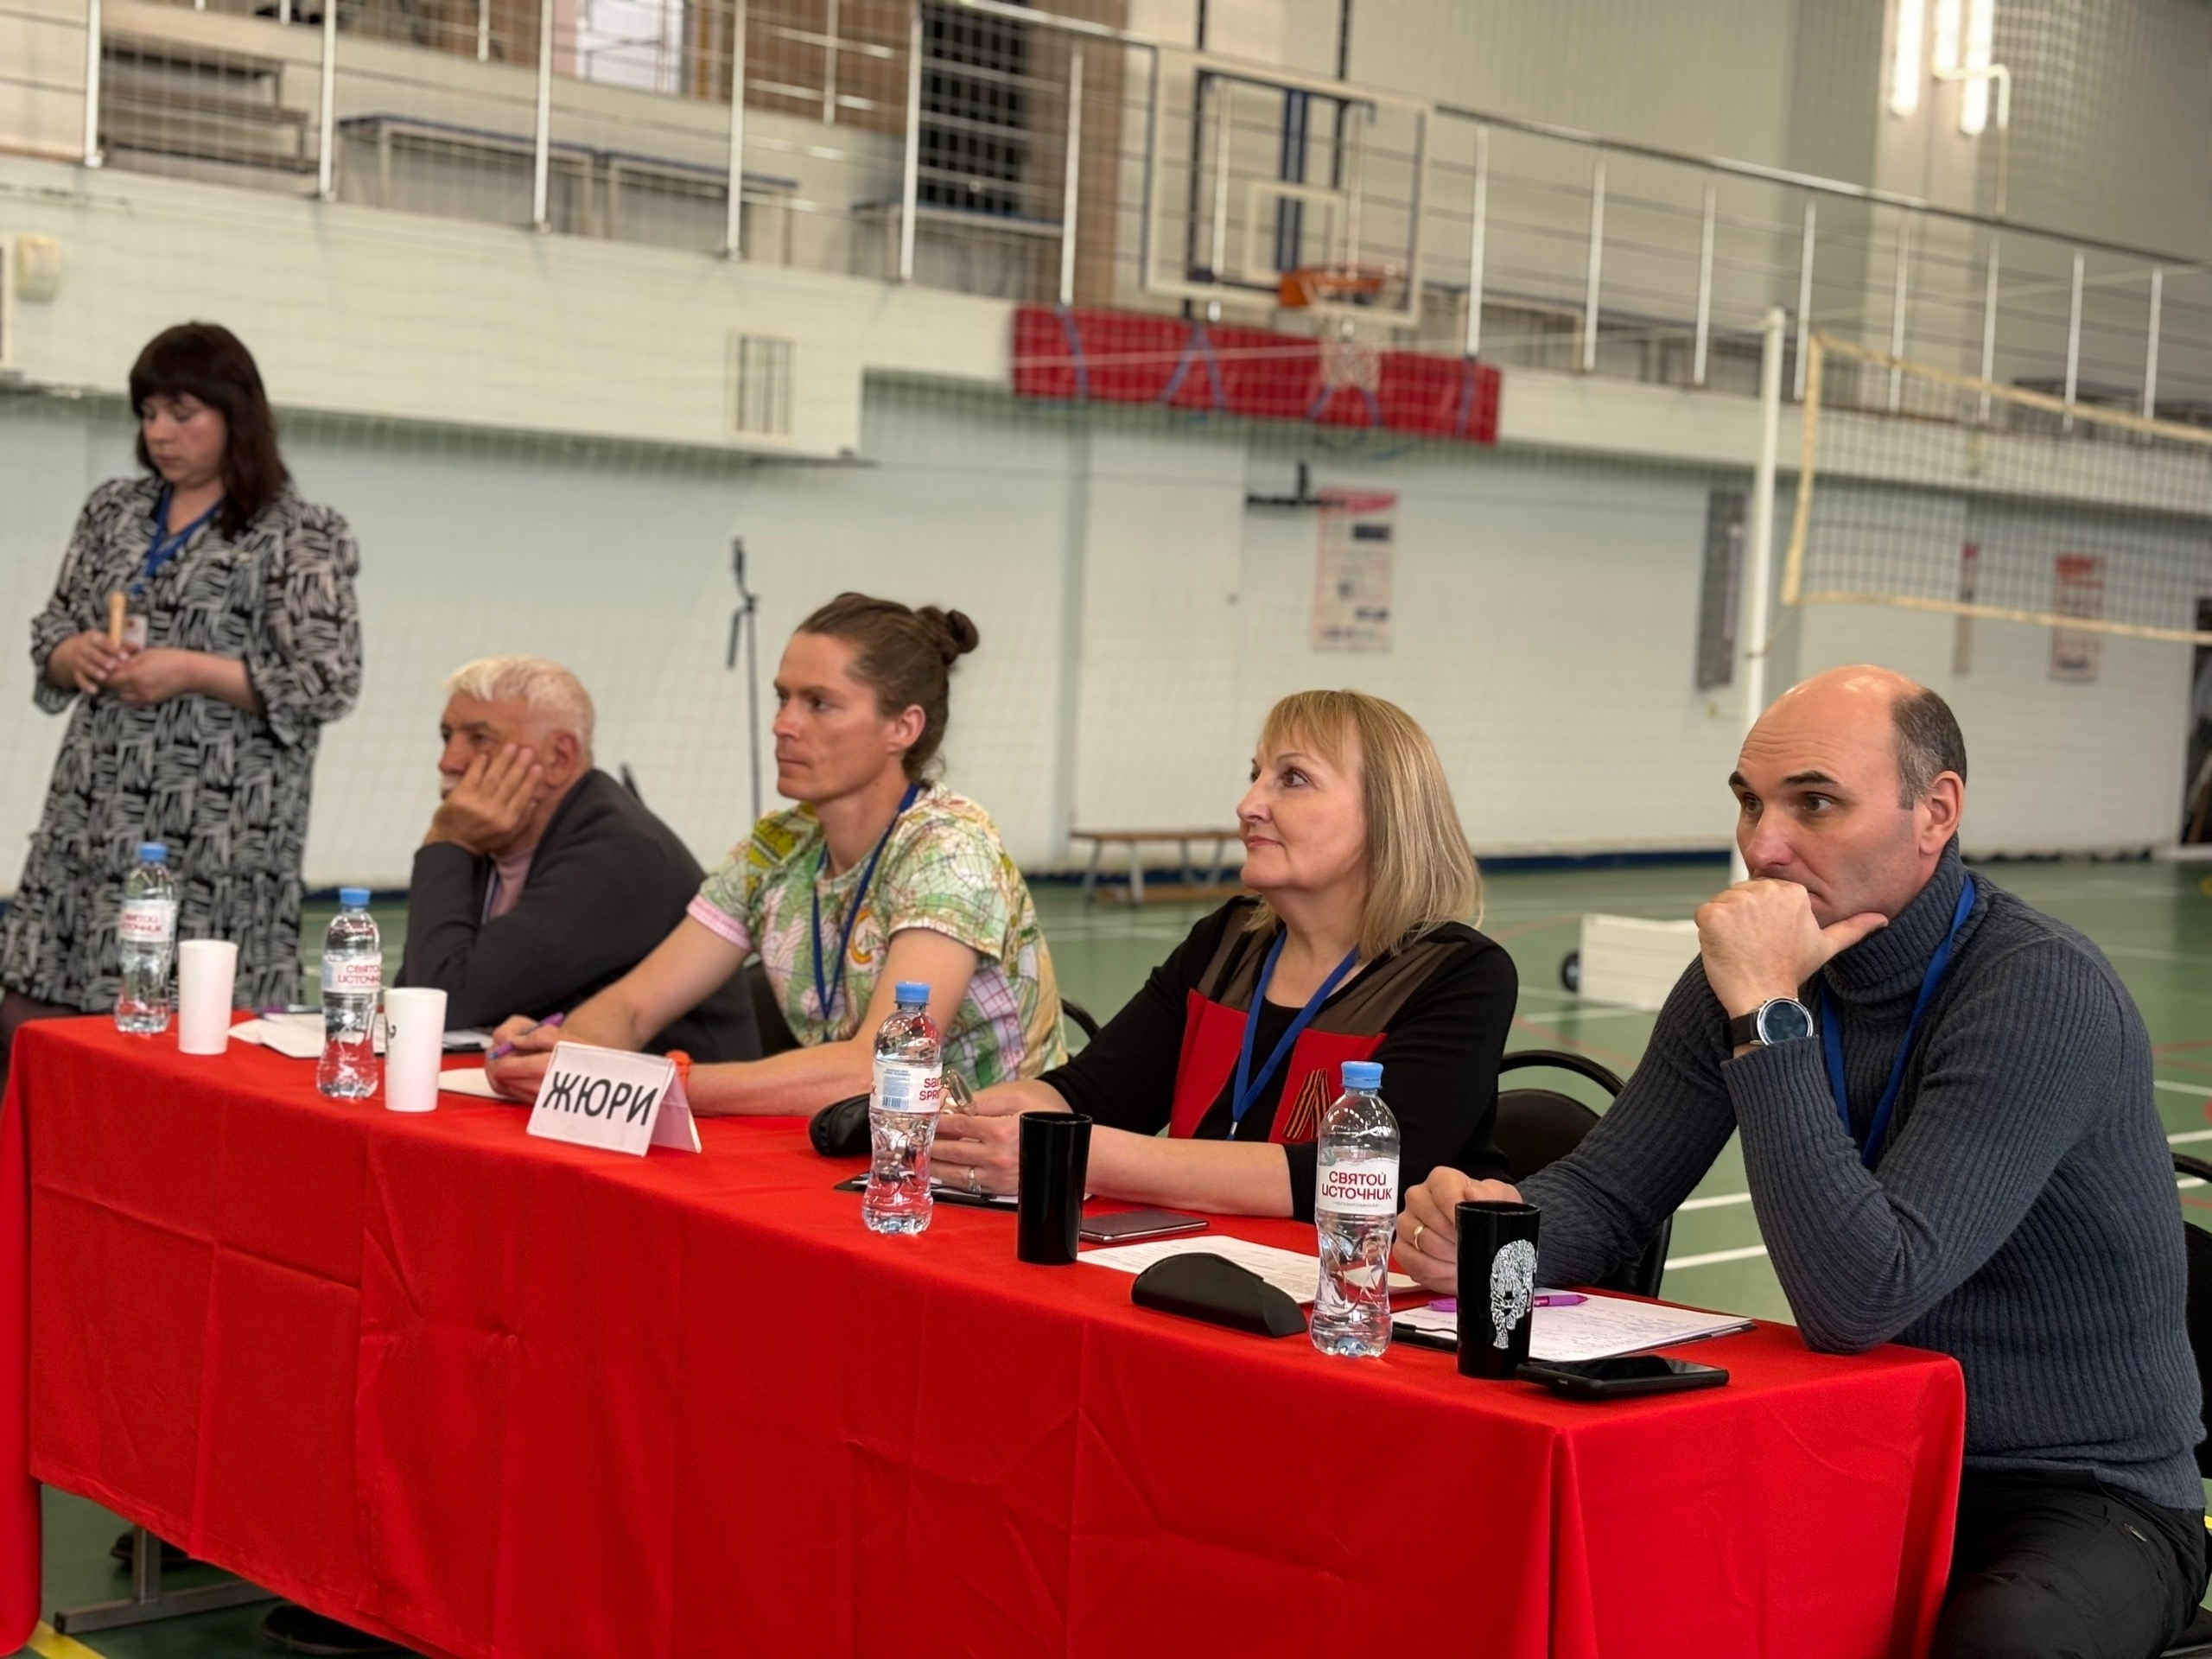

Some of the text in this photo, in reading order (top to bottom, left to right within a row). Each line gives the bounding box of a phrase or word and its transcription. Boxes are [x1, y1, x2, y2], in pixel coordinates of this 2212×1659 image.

[346, 964, 381, 974] СВЯТО
[542, 1071, 658, 1127] ЖЮРИ
[1329, 1171, 1387, 1186] СВЯТОЙ
[1321, 1183, 1393, 1201] ИСТОЧНИК
